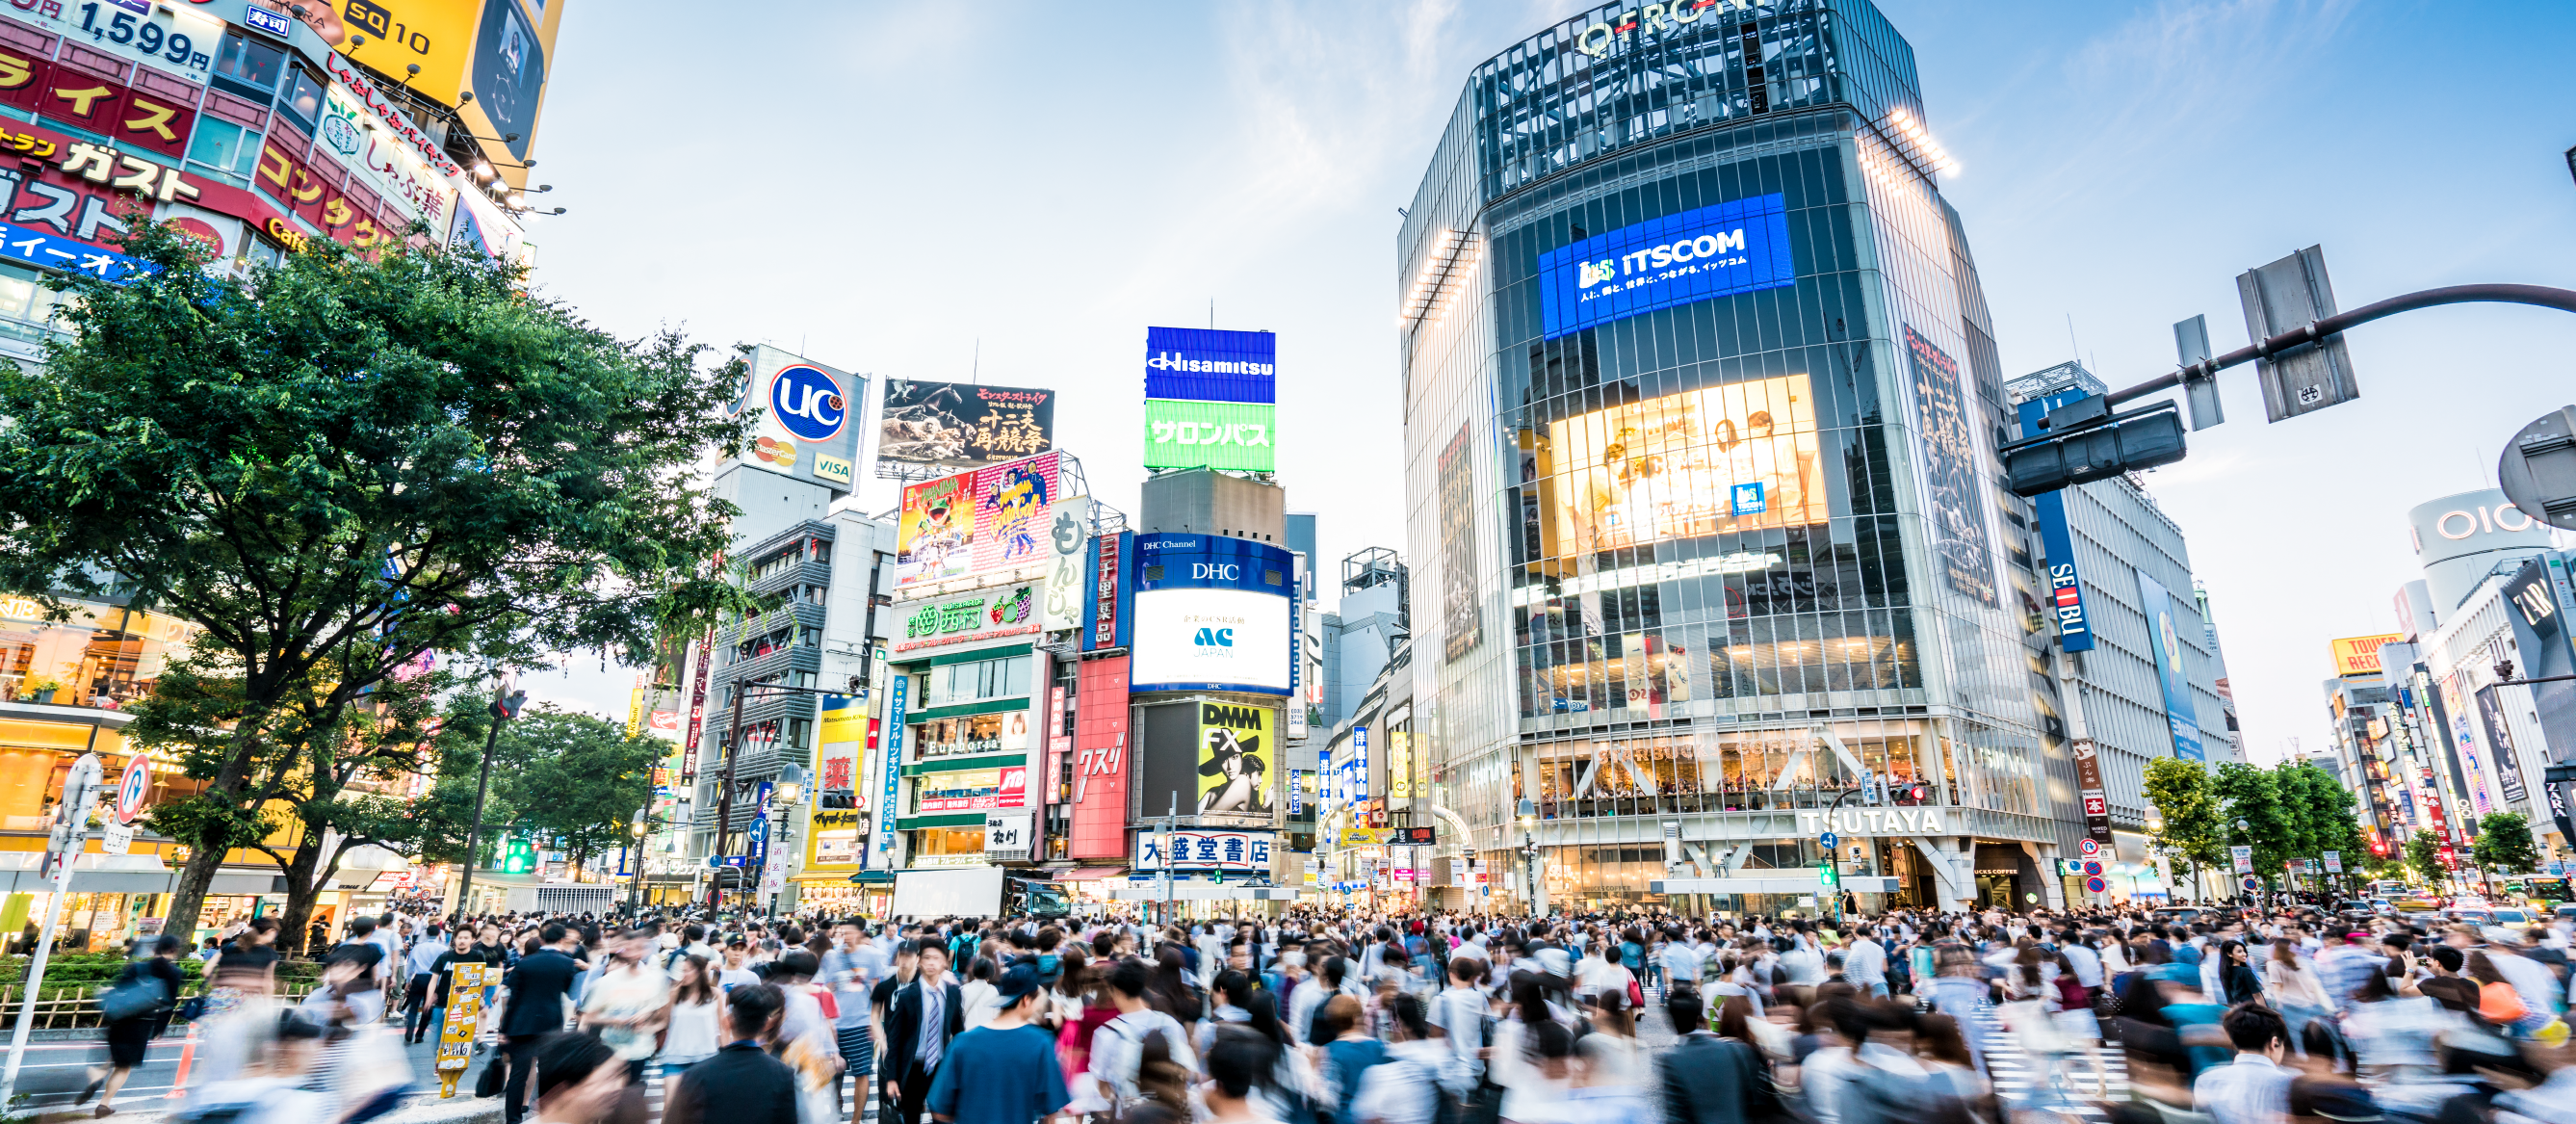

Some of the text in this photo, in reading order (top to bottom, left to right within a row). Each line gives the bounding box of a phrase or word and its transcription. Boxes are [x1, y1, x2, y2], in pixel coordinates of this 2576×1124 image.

[249, 11, 286, 33] 寿司
[349, 2, 430, 56] SQ 10
[80, 2, 211, 72] 1,599円
[327, 51, 460, 177] しゃぶしゃぶバイキング
[62, 139, 200, 202] ガスト
[366, 137, 445, 221] しゃぶ葉
[1148, 352, 1274, 376] Hisamitsu
[976, 388, 1048, 405] モンスターストライク
[1152, 419, 1270, 448] サロンパス
[820, 460, 849, 478] VISA
[1143, 539, 1196, 550] DHC Channel
[1048, 510, 1084, 625] もんじゃ
[1192, 562, 1239, 581] DHC
[2049, 562, 2085, 637] SEIBU
[939, 607, 982, 633] 西村
[1194, 628, 1233, 647] AC
[1193, 648, 1233, 658] JAPAN
[1203, 704, 1262, 730] DMM
[888, 697, 903, 784] サマーフルーツギフト
[927, 738, 999, 754] Euphoria
[1202, 728, 1242, 752] FX
[1598, 737, 1821, 765] STARBUCKS COFFEE
[824, 756, 851, 790] 薬
[1355, 730, 1366, 796] 洋服の青山
[2088, 799, 2103, 813] 本
[2546, 781, 2568, 818] ZARA
[1802, 810, 1942, 834] TSUTAYA
[1143, 836, 1269, 863] 大盛堂書店
[770, 848, 783, 888] 道玄坂
